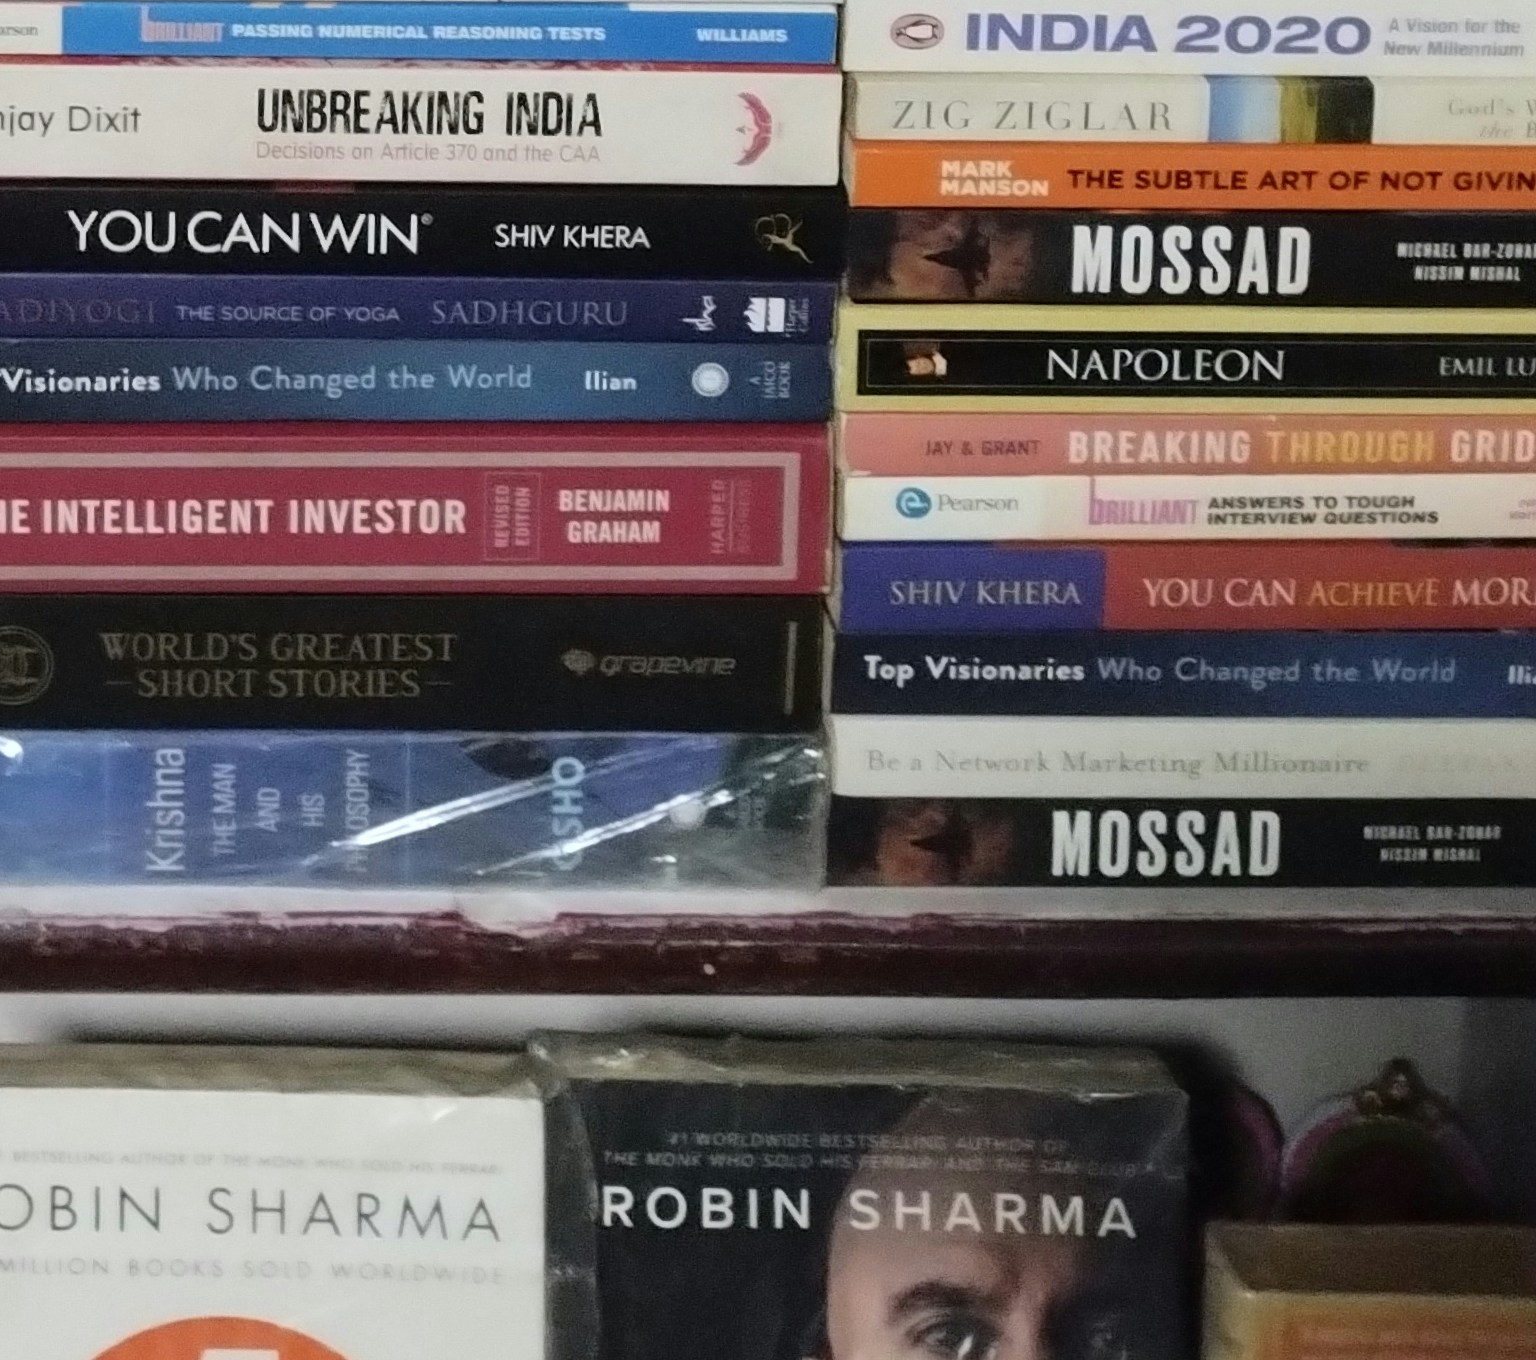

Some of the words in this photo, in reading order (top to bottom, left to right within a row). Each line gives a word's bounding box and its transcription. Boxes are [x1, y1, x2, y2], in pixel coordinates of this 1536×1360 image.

[965, 12, 1157, 53] INDIA
[1173, 14, 1372, 55] 2020
[67, 103, 142, 134] Dixit
[258, 87, 485, 137] UNBREAKING
[505, 90, 603, 138] INDIA
[940, 160, 1013, 178] MARK
[1067, 168, 1126, 190] THE
[1134, 168, 1247, 190] SUBTLE
[1258, 170, 1317, 191] ART
[1328, 170, 1371, 191] OF
[1380, 170, 1442, 192] NOT
[939, 178, 1048, 196] MANSON
[495, 223, 556, 249] SHIV
[562, 223, 650, 251] KHERA
[1071, 225, 1311, 296] MOSSAD
[1046, 347, 1286, 381] NAPOLEON
[42, 499, 274, 535] INTELLIGENT
[288, 500, 467, 535] INVESTOR
[558, 489, 671, 513] BENJAMIN
[566, 520, 661, 543] GRAHAM
[206, 1181, 504, 1244] SHARMA
[601, 1184, 811, 1229] ROBIN
[848, 1190, 1137, 1241] SHARMA
